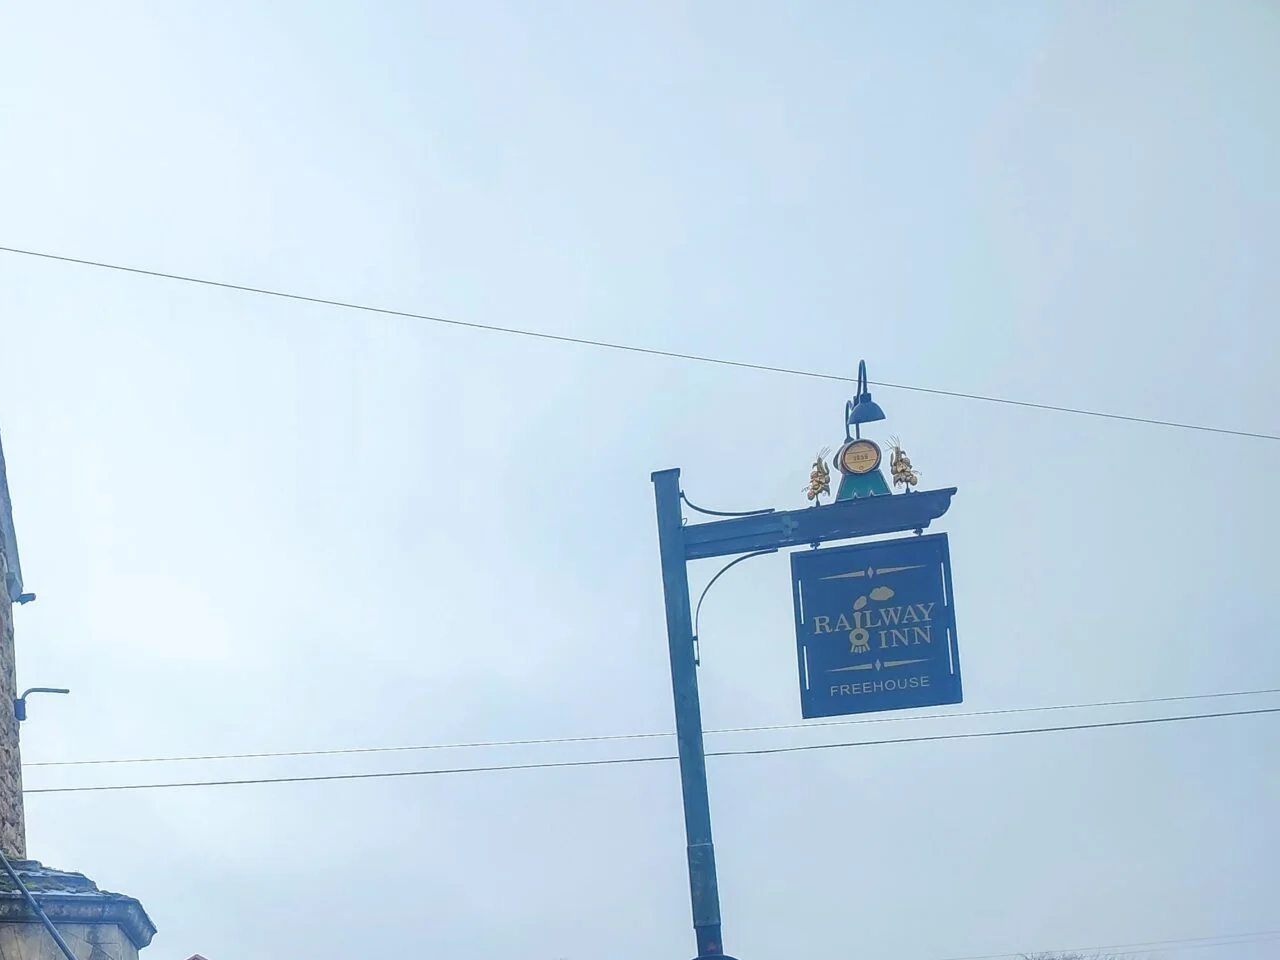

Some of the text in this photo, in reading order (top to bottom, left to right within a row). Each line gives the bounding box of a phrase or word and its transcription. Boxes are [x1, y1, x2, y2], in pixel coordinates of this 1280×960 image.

[813, 602, 936, 635] RAILWAY
[879, 626, 933, 649] INN
[830, 676, 931, 697] FREEHOUSE
